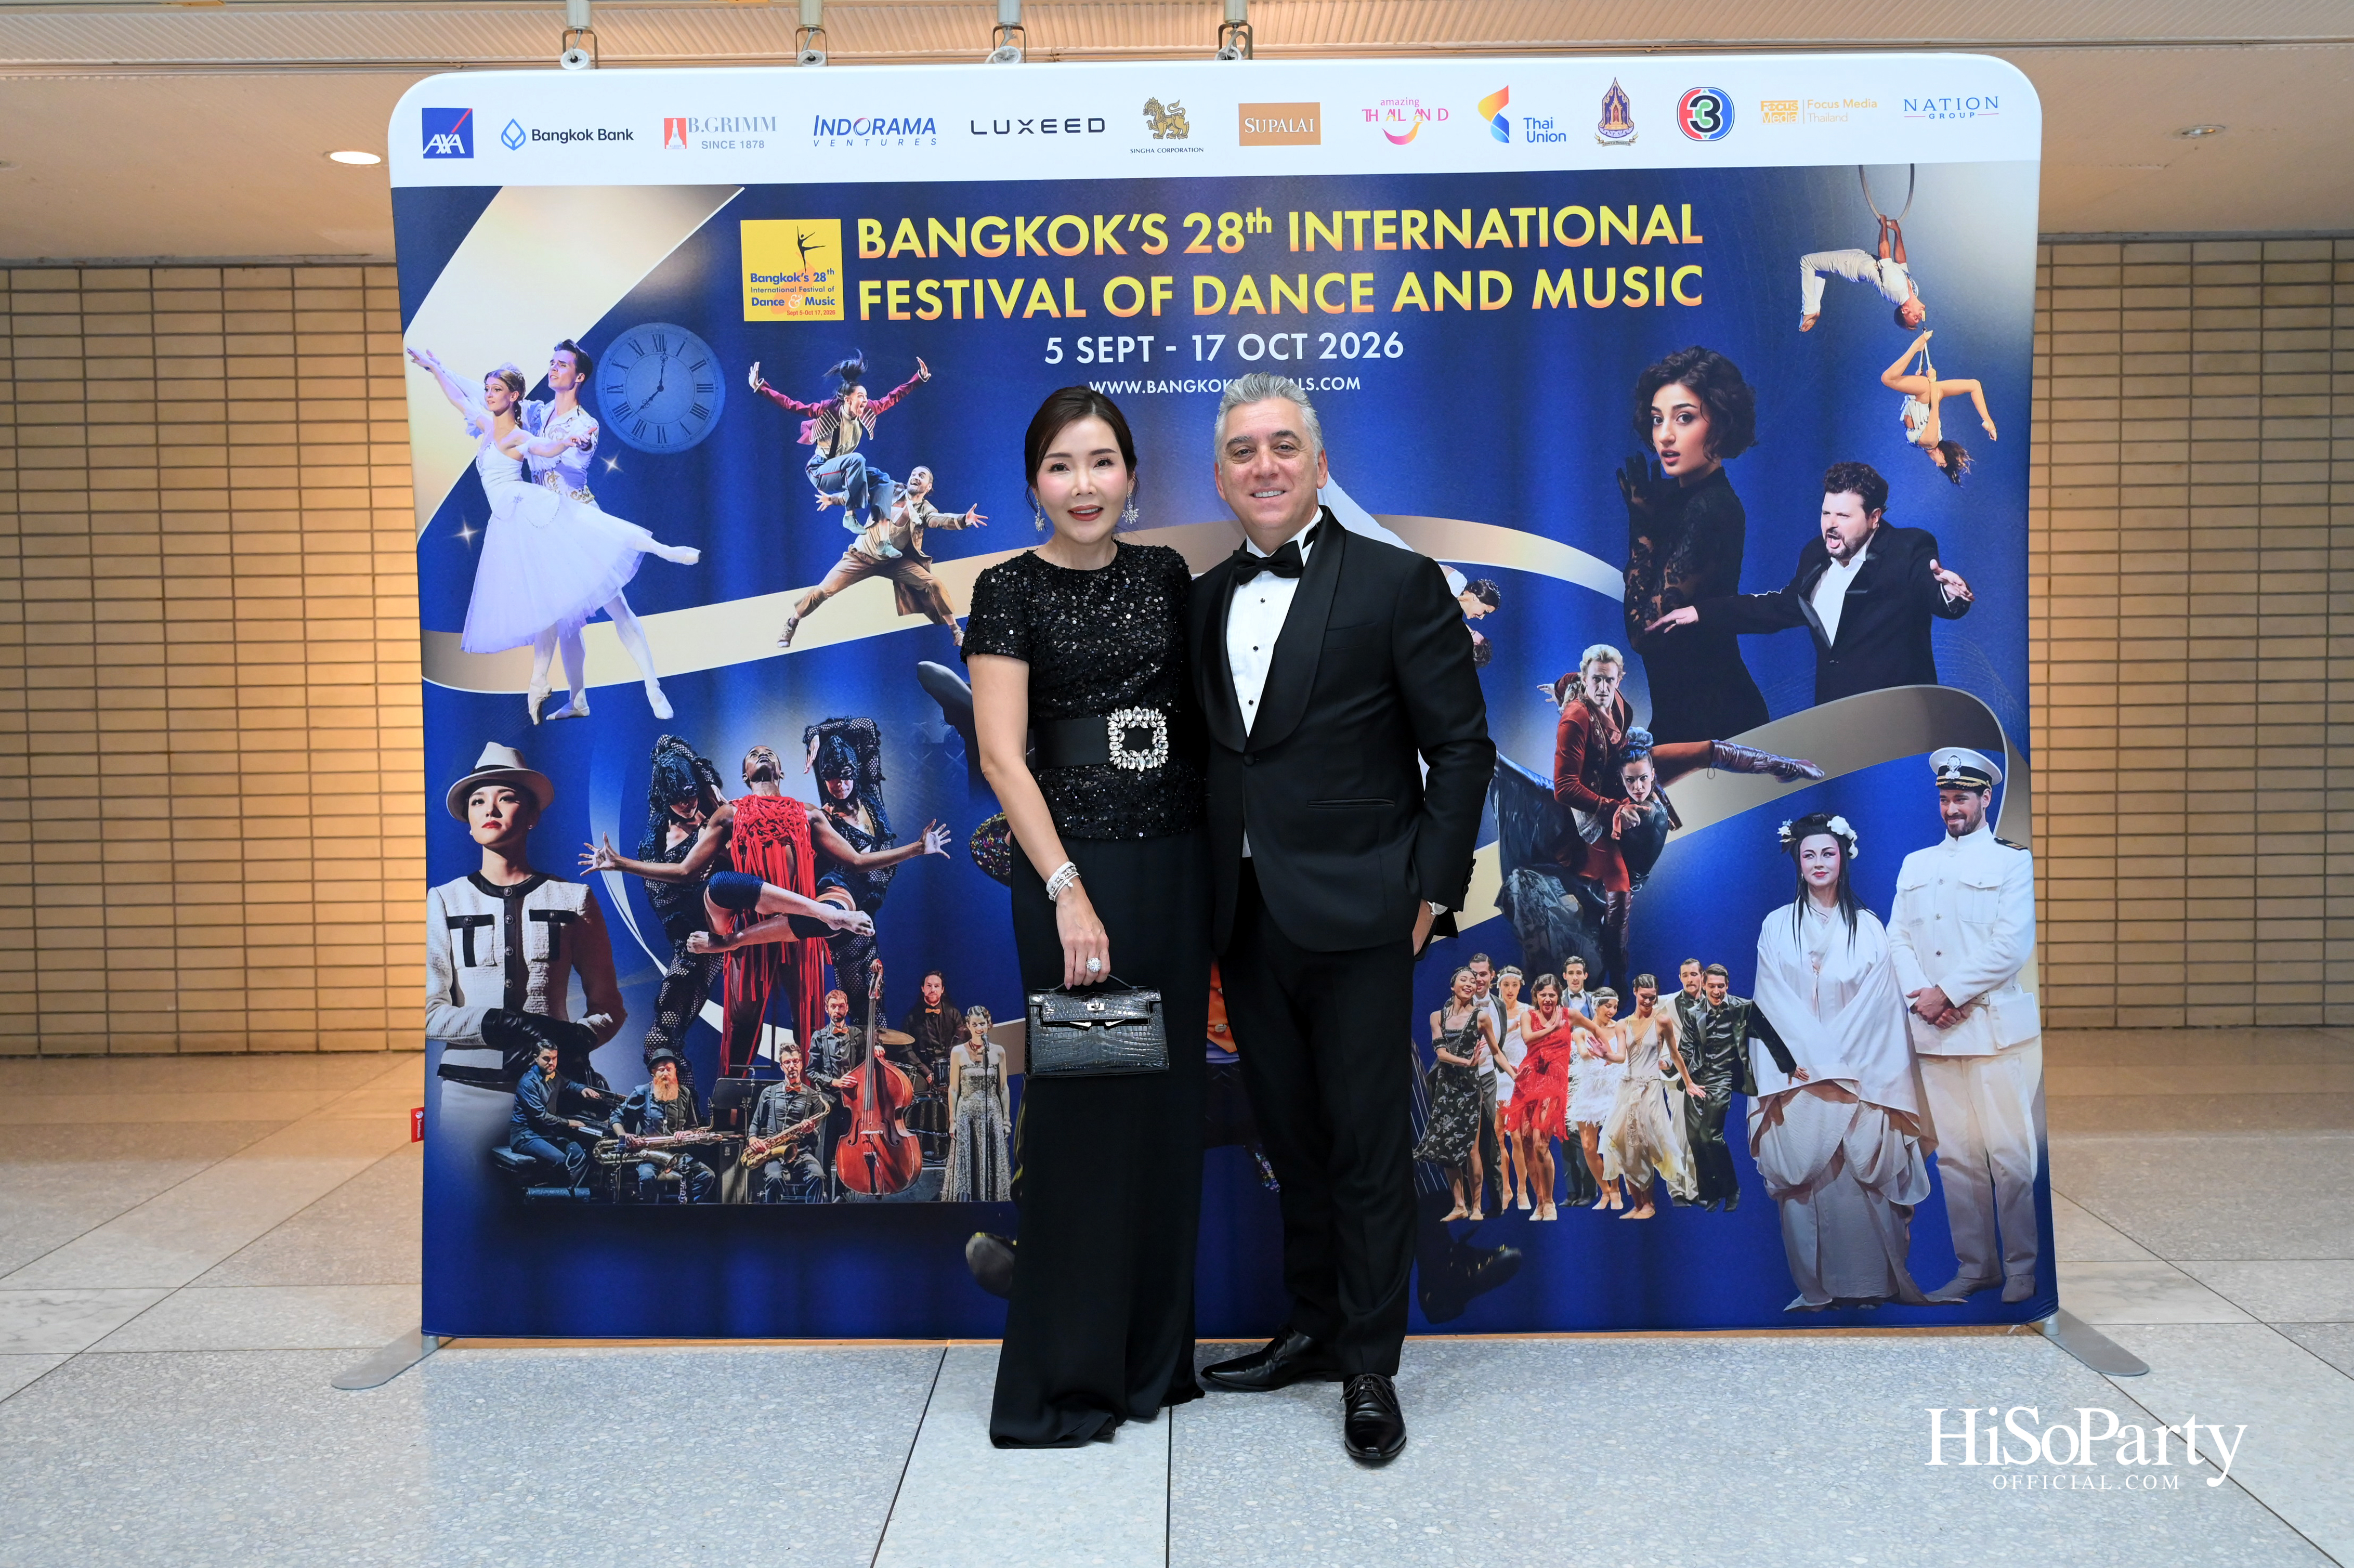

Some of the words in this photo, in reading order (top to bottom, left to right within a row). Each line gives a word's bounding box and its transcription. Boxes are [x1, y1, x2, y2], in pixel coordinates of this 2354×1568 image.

[1381, 97, 1419, 107] amazing
[1808, 99, 1840, 109] Focus
[1843, 98, 1877, 108] Media
[1904, 96, 1998, 111] NATION
[1689, 95, 1721, 133] 3
[1762, 112, 1798, 123] Media
[1807, 112, 1848, 122] Thailand
[1929, 110, 1974, 119] GROUP
[688, 116, 778, 133] B.GRIMM
[814, 115, 936, 136] INDORAMA
[971, 118, 1105, 135] LUXEED
[1245, 117, 1314, 133] SUPALAI
[1523, 117, 1553, 129] Thai
[532, 129, 594, 143] Bangkok
[598, 129, 634, 140] Bank
[814, 138, 936, 147] VENTURES
[1527, 131, 1566, 143] Union
[423, 134, 465, 154] AXA
[702, 140, 735, 149] SINCE
[740, 140, 764, 149] 1878
[858, 213, 1168, 258] BANGKOK'S
[1183, 207, 1272, 253] 28th
[1288, 203, 1703, 252] INTERNATIONAL
[750, 272, 809, 285] Bangkok's
[813, 268, 835, 282] 28th
[859, 278, 1086, 320] FESTIVAL
[1103, 276, 1173, 317] OF
[1194, 272, 1374, 315] DANCE
[1391, 270, 1512, 312] AND
[1532, 265, 1702, 309] MUSIC
[752, 297, 785, 306] Dance
[789, 294, 803, 309] &
[805, 296, 835, 305] Music
[1045, 337, 1063, 364] 5
[1077, 336, 1154, 363] SEPT
[1192, 334, 1226, 361] 17
[1238, 333, 1307, 360] OCT
[1318, 331, 1403, 359] 2026
